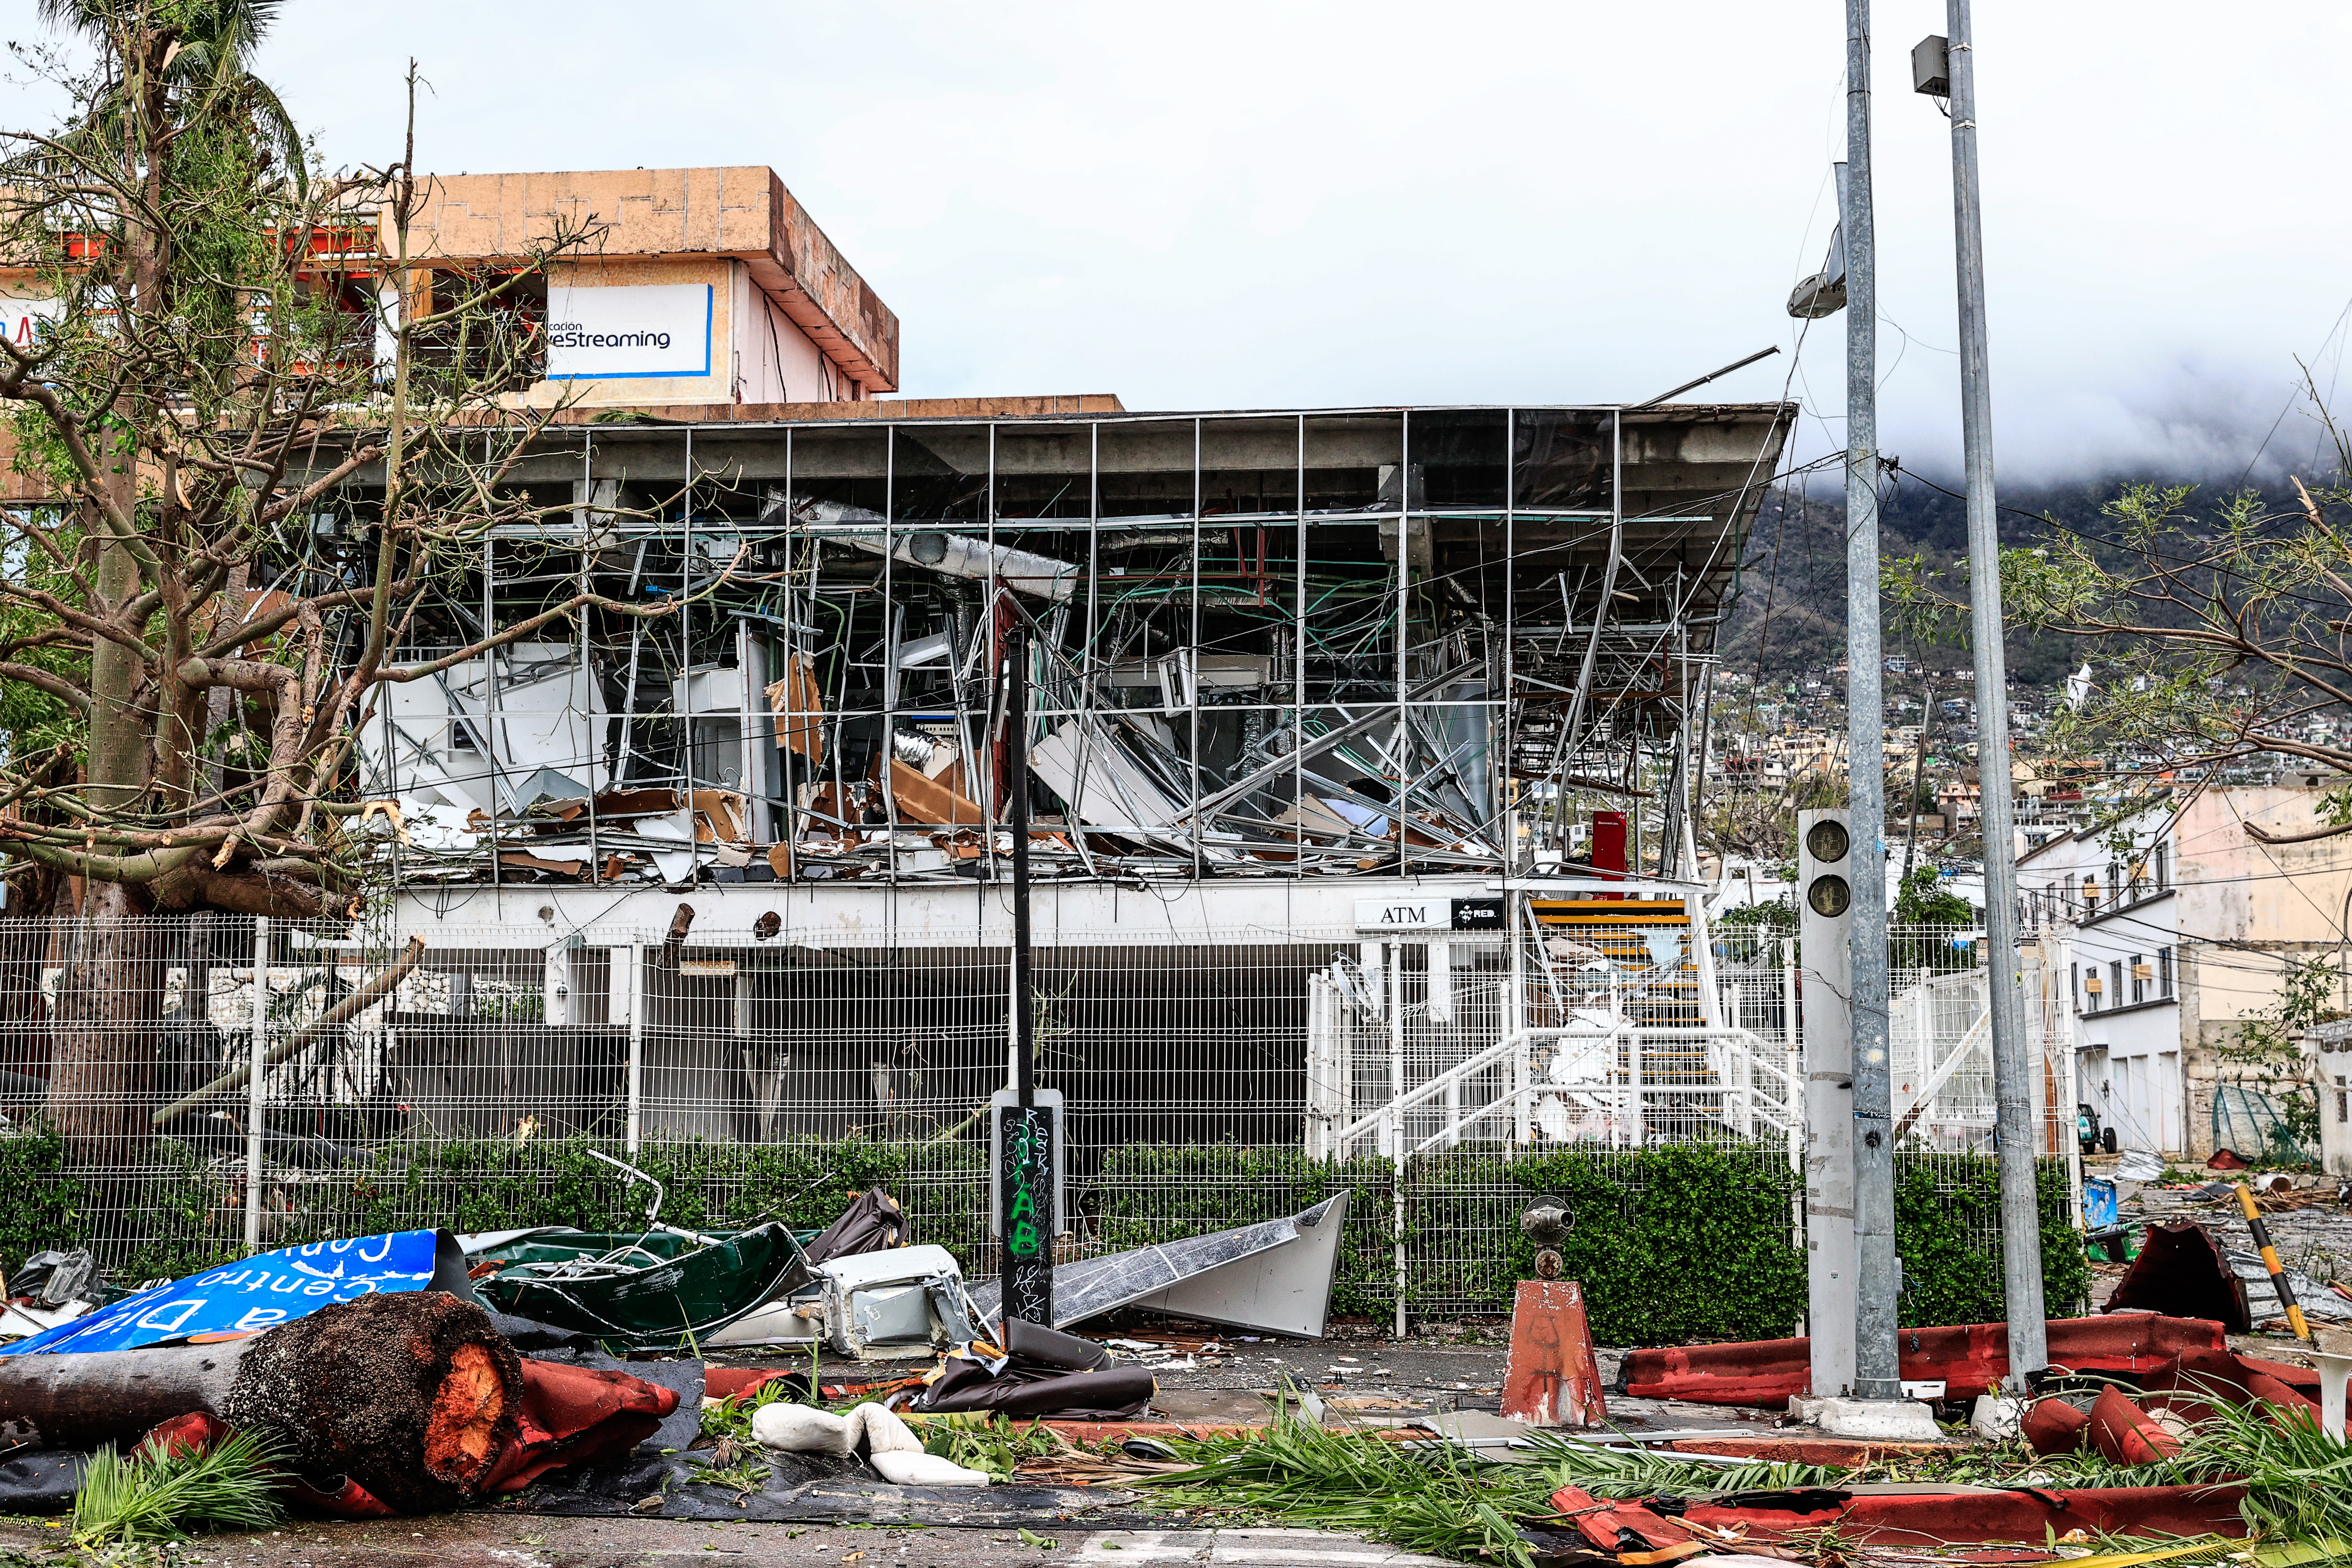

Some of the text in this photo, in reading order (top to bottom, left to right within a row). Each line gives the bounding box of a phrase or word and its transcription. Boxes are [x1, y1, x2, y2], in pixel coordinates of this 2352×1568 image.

[549, 321, 582, 331] cación
[1381, 906, 1427, 923] ATM
[197, 1268, 377, 1302] Centro
